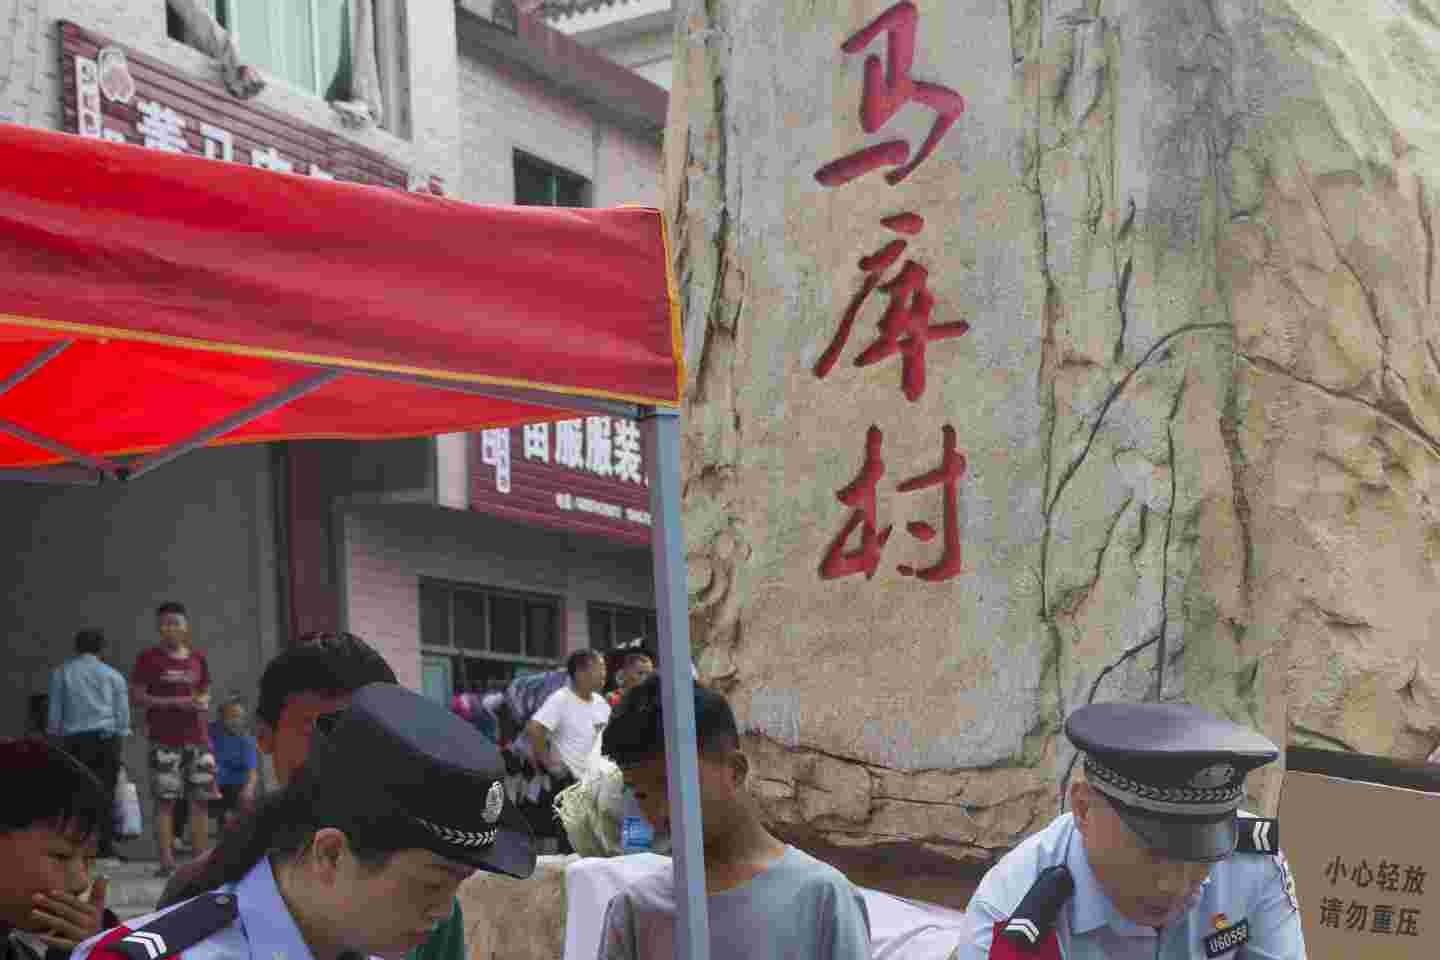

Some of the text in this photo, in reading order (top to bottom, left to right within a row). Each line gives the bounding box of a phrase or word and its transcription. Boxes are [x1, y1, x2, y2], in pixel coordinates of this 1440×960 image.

[1323, 856, 1427, 897] 小心轻放
[1318, 898, 1423, 938] 请勿重压
